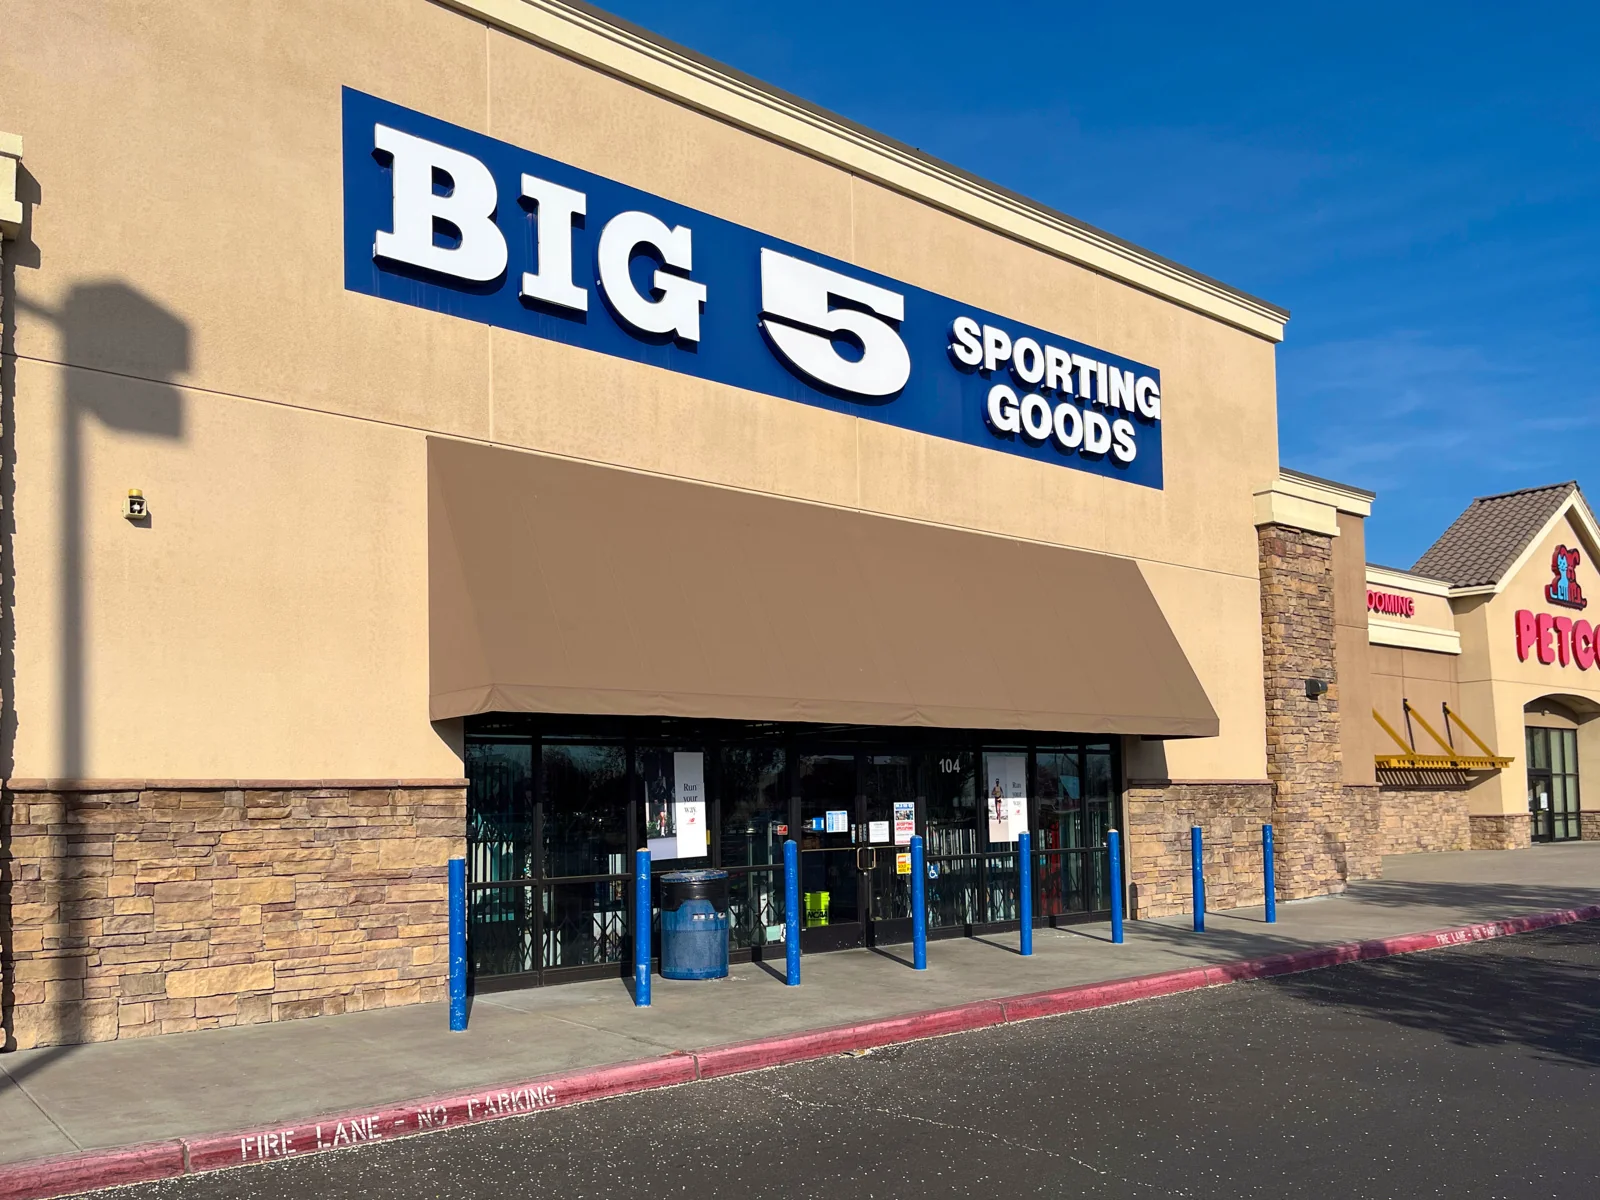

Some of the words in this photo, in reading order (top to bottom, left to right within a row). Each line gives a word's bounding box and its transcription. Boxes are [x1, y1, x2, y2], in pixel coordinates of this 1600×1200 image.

[373, 122, 708, 343] BIG
[759, 247, 911, 396] 5
[950, 316, 1161, 420] SPORTING
[986, 384, 1137, 463] GOODS
[1515, 609, 1600, 672] PETC
[683, 783, 698, 792] Run
[683, 795, 699, 805] your
[939, 758, 961, 773] 104
[240, 1130, 297, 1161] FIRE
[315, 1116, 383, 1149] LANE
[417, 1104, 449, 1129] NO
[466, 1084, 557, 1121] PARKING
